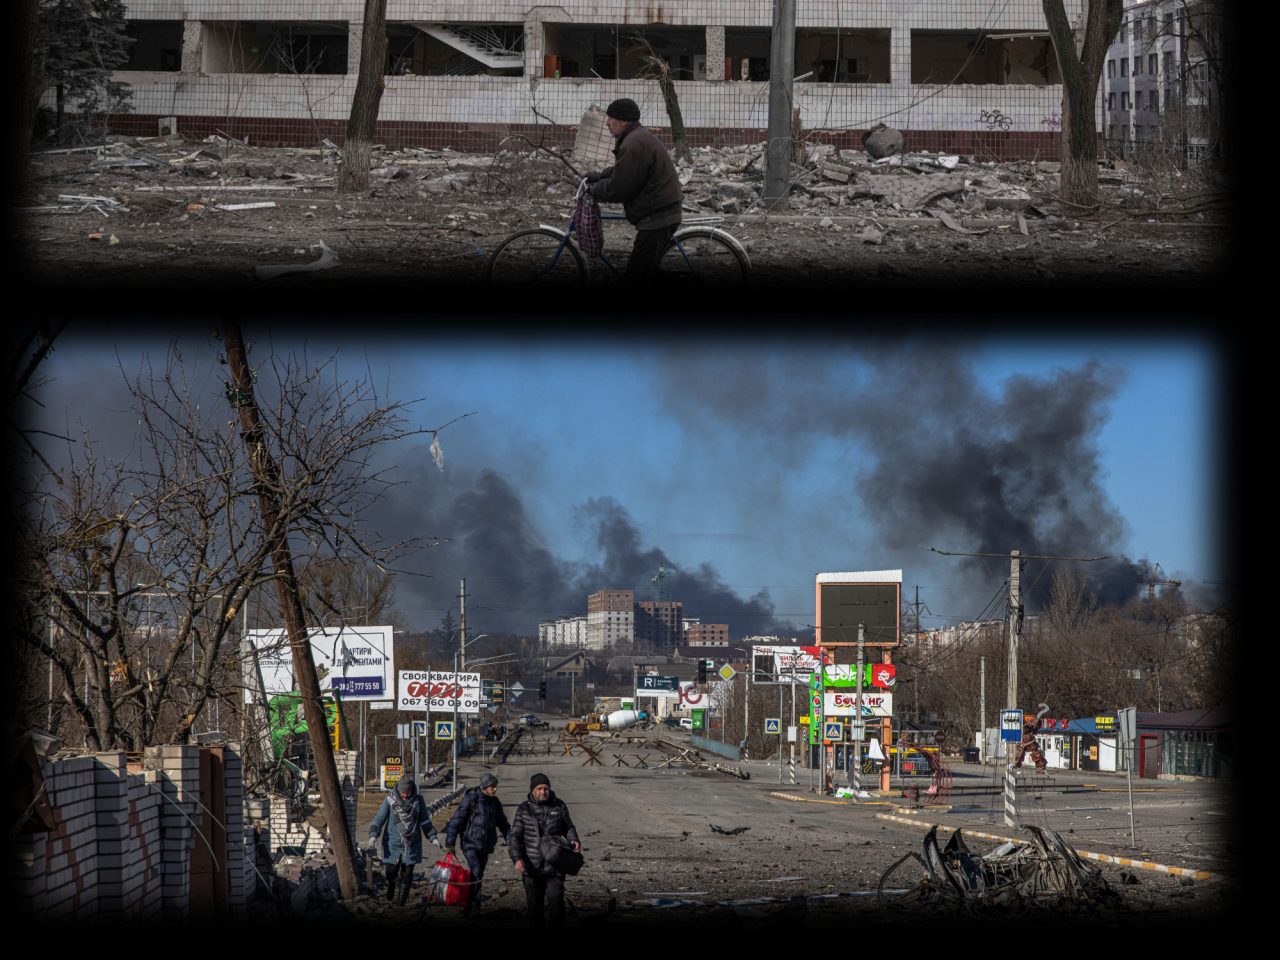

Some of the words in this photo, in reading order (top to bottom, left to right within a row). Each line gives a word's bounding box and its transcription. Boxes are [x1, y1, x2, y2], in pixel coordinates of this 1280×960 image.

[340, 647, 372, 656] КАРТИРИ
[402, 672, 427, 680] СВОЯ
[430, 673, 479, 682] КВАРТИРА
[401, 698, 421, 706] 067
[464, 700, 479, 708] 09
